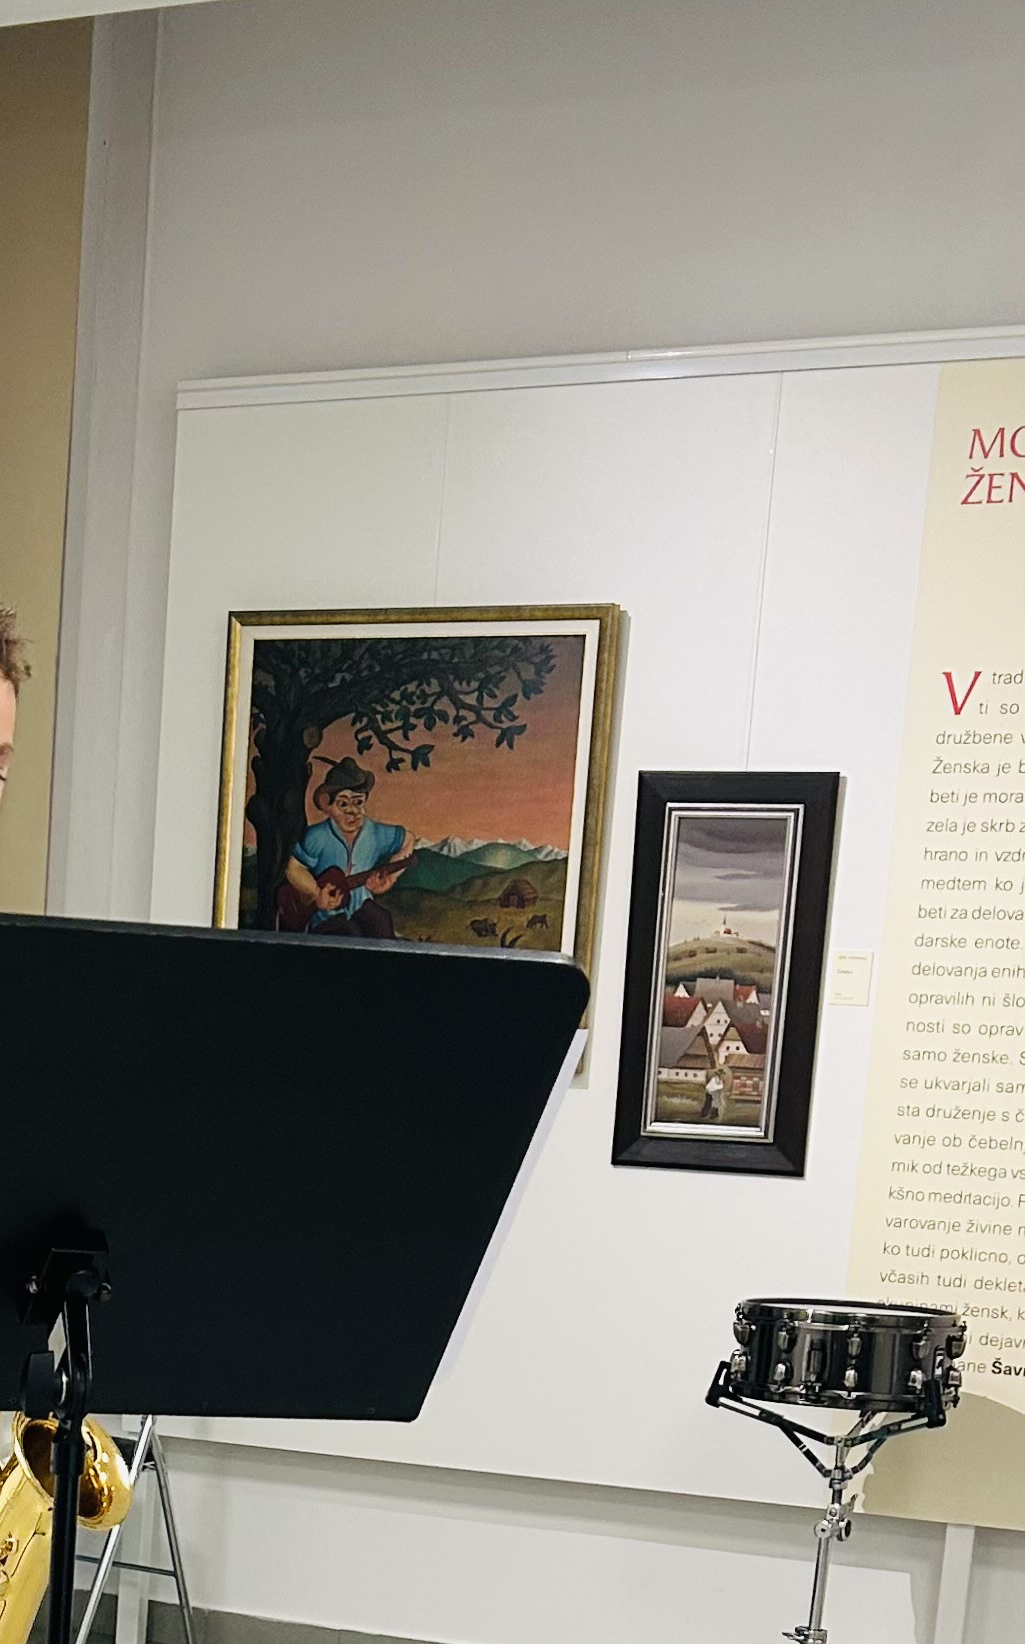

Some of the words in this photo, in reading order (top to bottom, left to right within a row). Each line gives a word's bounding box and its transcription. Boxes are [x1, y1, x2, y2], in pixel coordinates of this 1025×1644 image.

[942, 671, 982, 715] V
[979, 701, 989, 715] ti
[999, 703, 1019, 715] so
[935, 730, 1013, 745] družbene
[932, 755, 990, 775] Ženska
[995, 758, 1012, 778] je
[930, 788, 960, 804] beti
[961, 789, 978, 806] je
[982, 791, 1024, 804] mora
[925, 818, 958, 833] zela
[960, 818, 976, 836] je
[980, 817, 1015, 833] skrb
[923, 846, 968, 862] hrano
[974, 847, 988, 862] in
[920, 876, 987, 892] medtem
[995, 877, 1014, 891] ko
[918, 904, 947, 920] beti
[949, 907, 968, 920] za
[971, 905, 1024, 922] delova
[914, 932, 967, 949] darske
[911, 961, 988, 981] delovanja
[991, 964, 1025, 979] enih
[908, 990, 975, 1008] opravilih
[982, 993, 996, 1007] ni
[1002, 992, 1025, 1008] šlo
[906, 1019, 945, 1034] nosti
[952, 1022, 972, 1035] so
[978, 1024, 1024, 1038] oprav
[902, 1049, 947, 1062] samo
[899, 1077, 919, 1090] se
[924, 1076, 991, 1095] ukvarjali
[896, 1104, 921, 1117] sta
[925, 1104, 997, 1125] druženje
[1001, 1110, 1010, 1122] s
[894, 1132, 936, 1149] vanje
[941, 1133, 963, 1148] ob
[891, 1160, 919, 1173] mik
[922, 1161, 944, 1175] od
[946, 1162, 1008, 1182] težkega
[888, 1185, 925, 1202] kšno
[885, 1215, 961, 1235] varovanje
[965, 1218, 1013, 1237] živine
[882, 1241, 902, 1256] ko
[905, 1245, 936, 1259] tudi
[939, 1246, 1013, 1267] poklicno,
[879, 1269, 930, 1286] včasih
[936, 1272, 967, 1289] tudi
[961, 1303, 1013, 1322] žensk,
